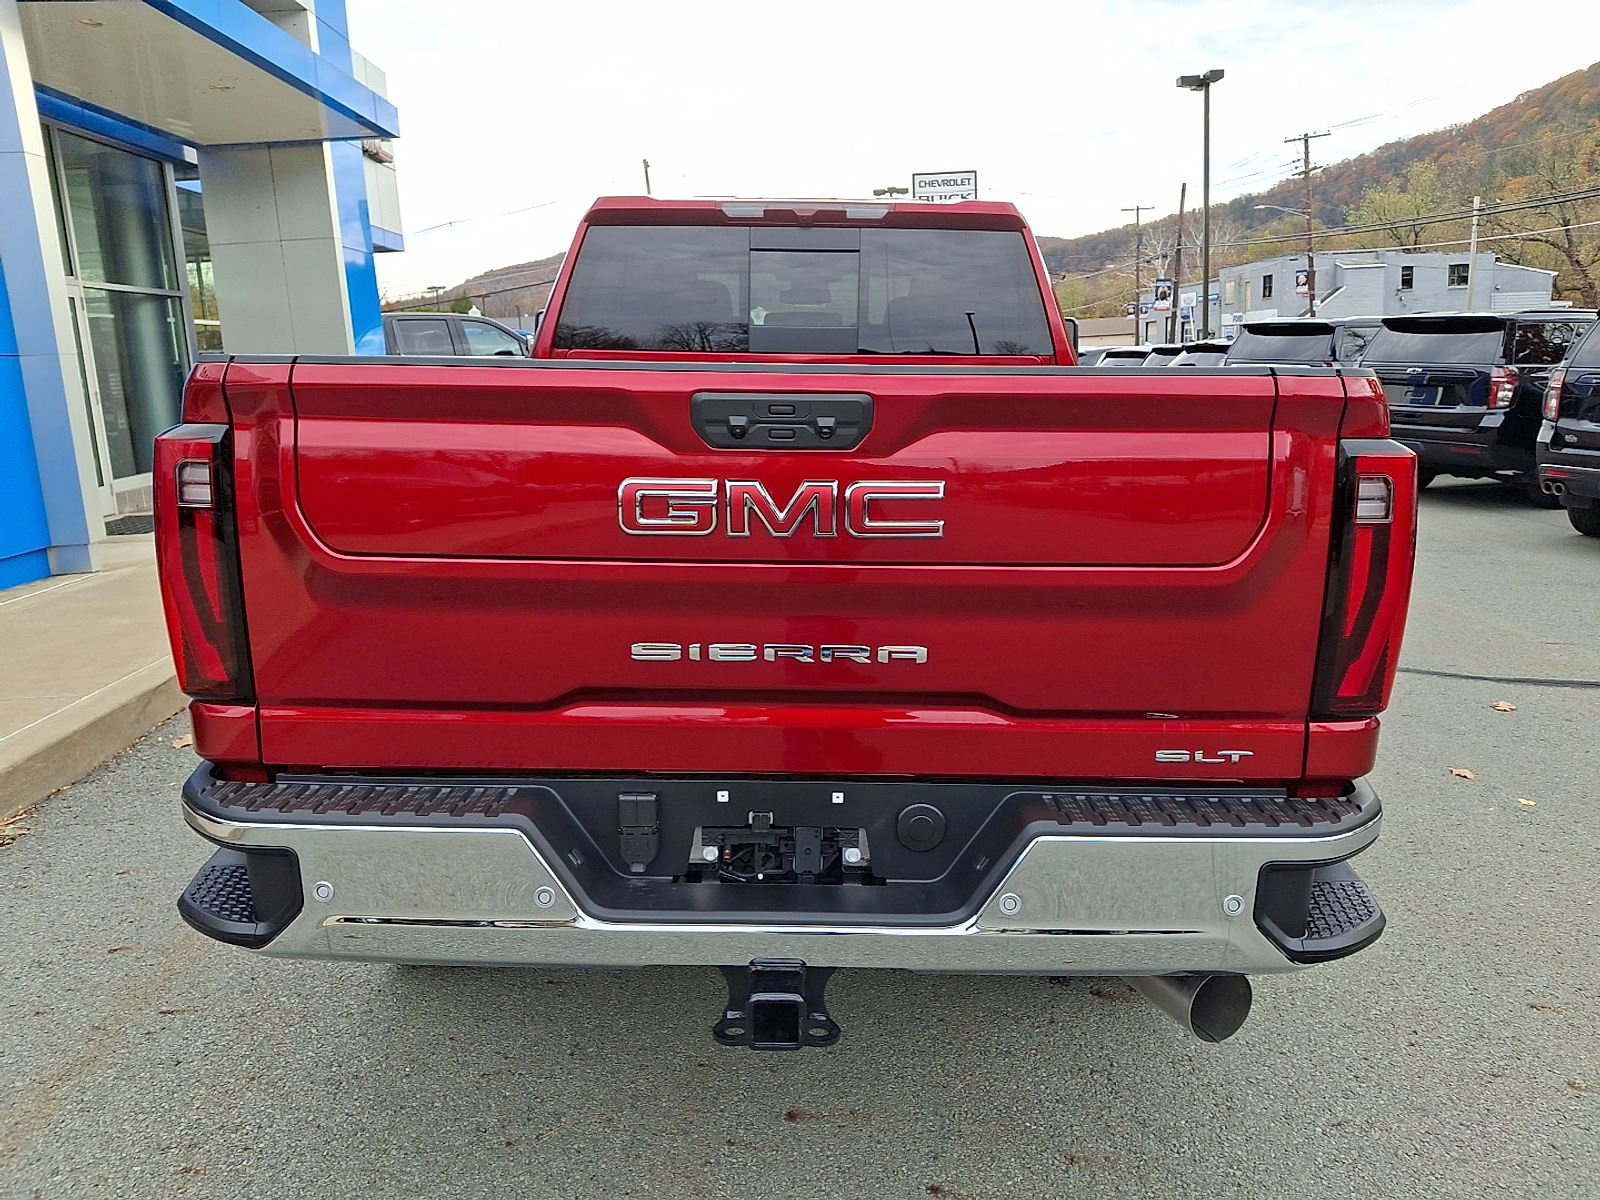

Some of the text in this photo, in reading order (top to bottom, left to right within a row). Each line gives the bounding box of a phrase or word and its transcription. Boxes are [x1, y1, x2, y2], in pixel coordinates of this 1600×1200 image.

[918, 178, 972, 188] CHEVROLET
[617, 477, 946, 537] GMC
[630, 643, 928, 663] SIERRA
[1155, 750, 1254, 763] SLT
